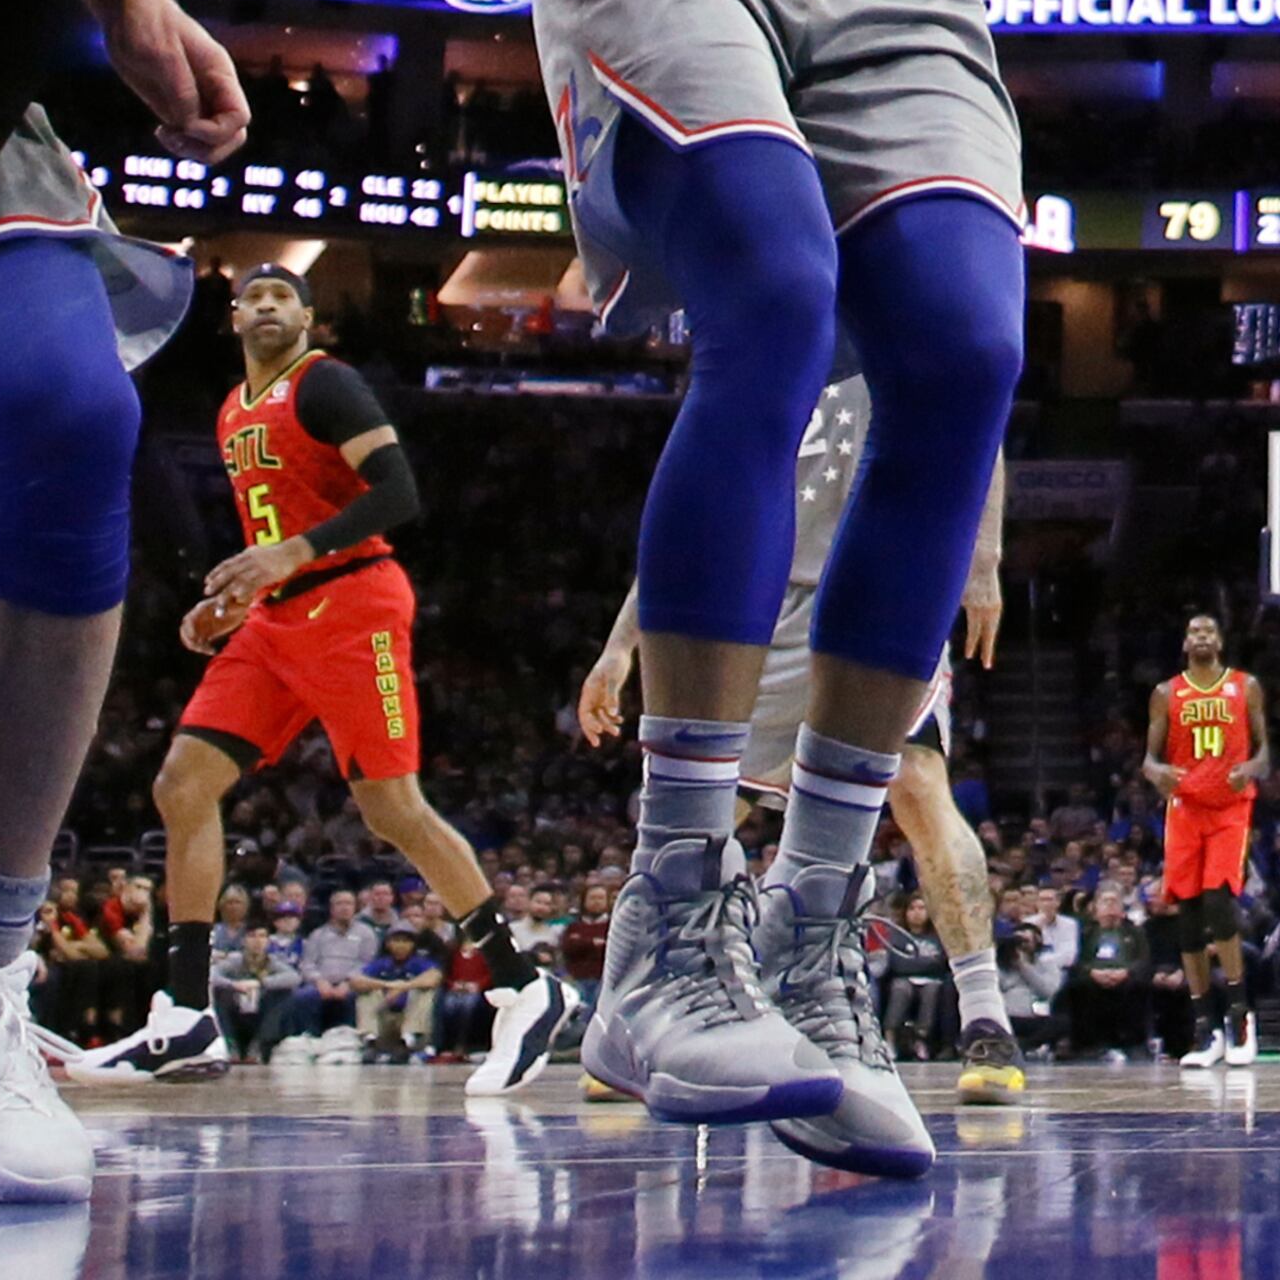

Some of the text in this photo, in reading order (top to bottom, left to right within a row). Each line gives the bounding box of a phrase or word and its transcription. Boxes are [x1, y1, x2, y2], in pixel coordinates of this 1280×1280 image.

[122, 183, 169, 206] TOR
[329, 186, 347, 207] 2
[361, 175, 405, 197] CLE
[473, 181, 563, 205] PLAYER
[242, 193, 276, 214] NY
[474, 209, 561, 232] POINTS
[1159, 200, 1222, 241] 79
[371, 631, 404, 739] HAWKS
[1180, 696, 1234, 725] ATL
[1192, 725, 1224, 760] 14
